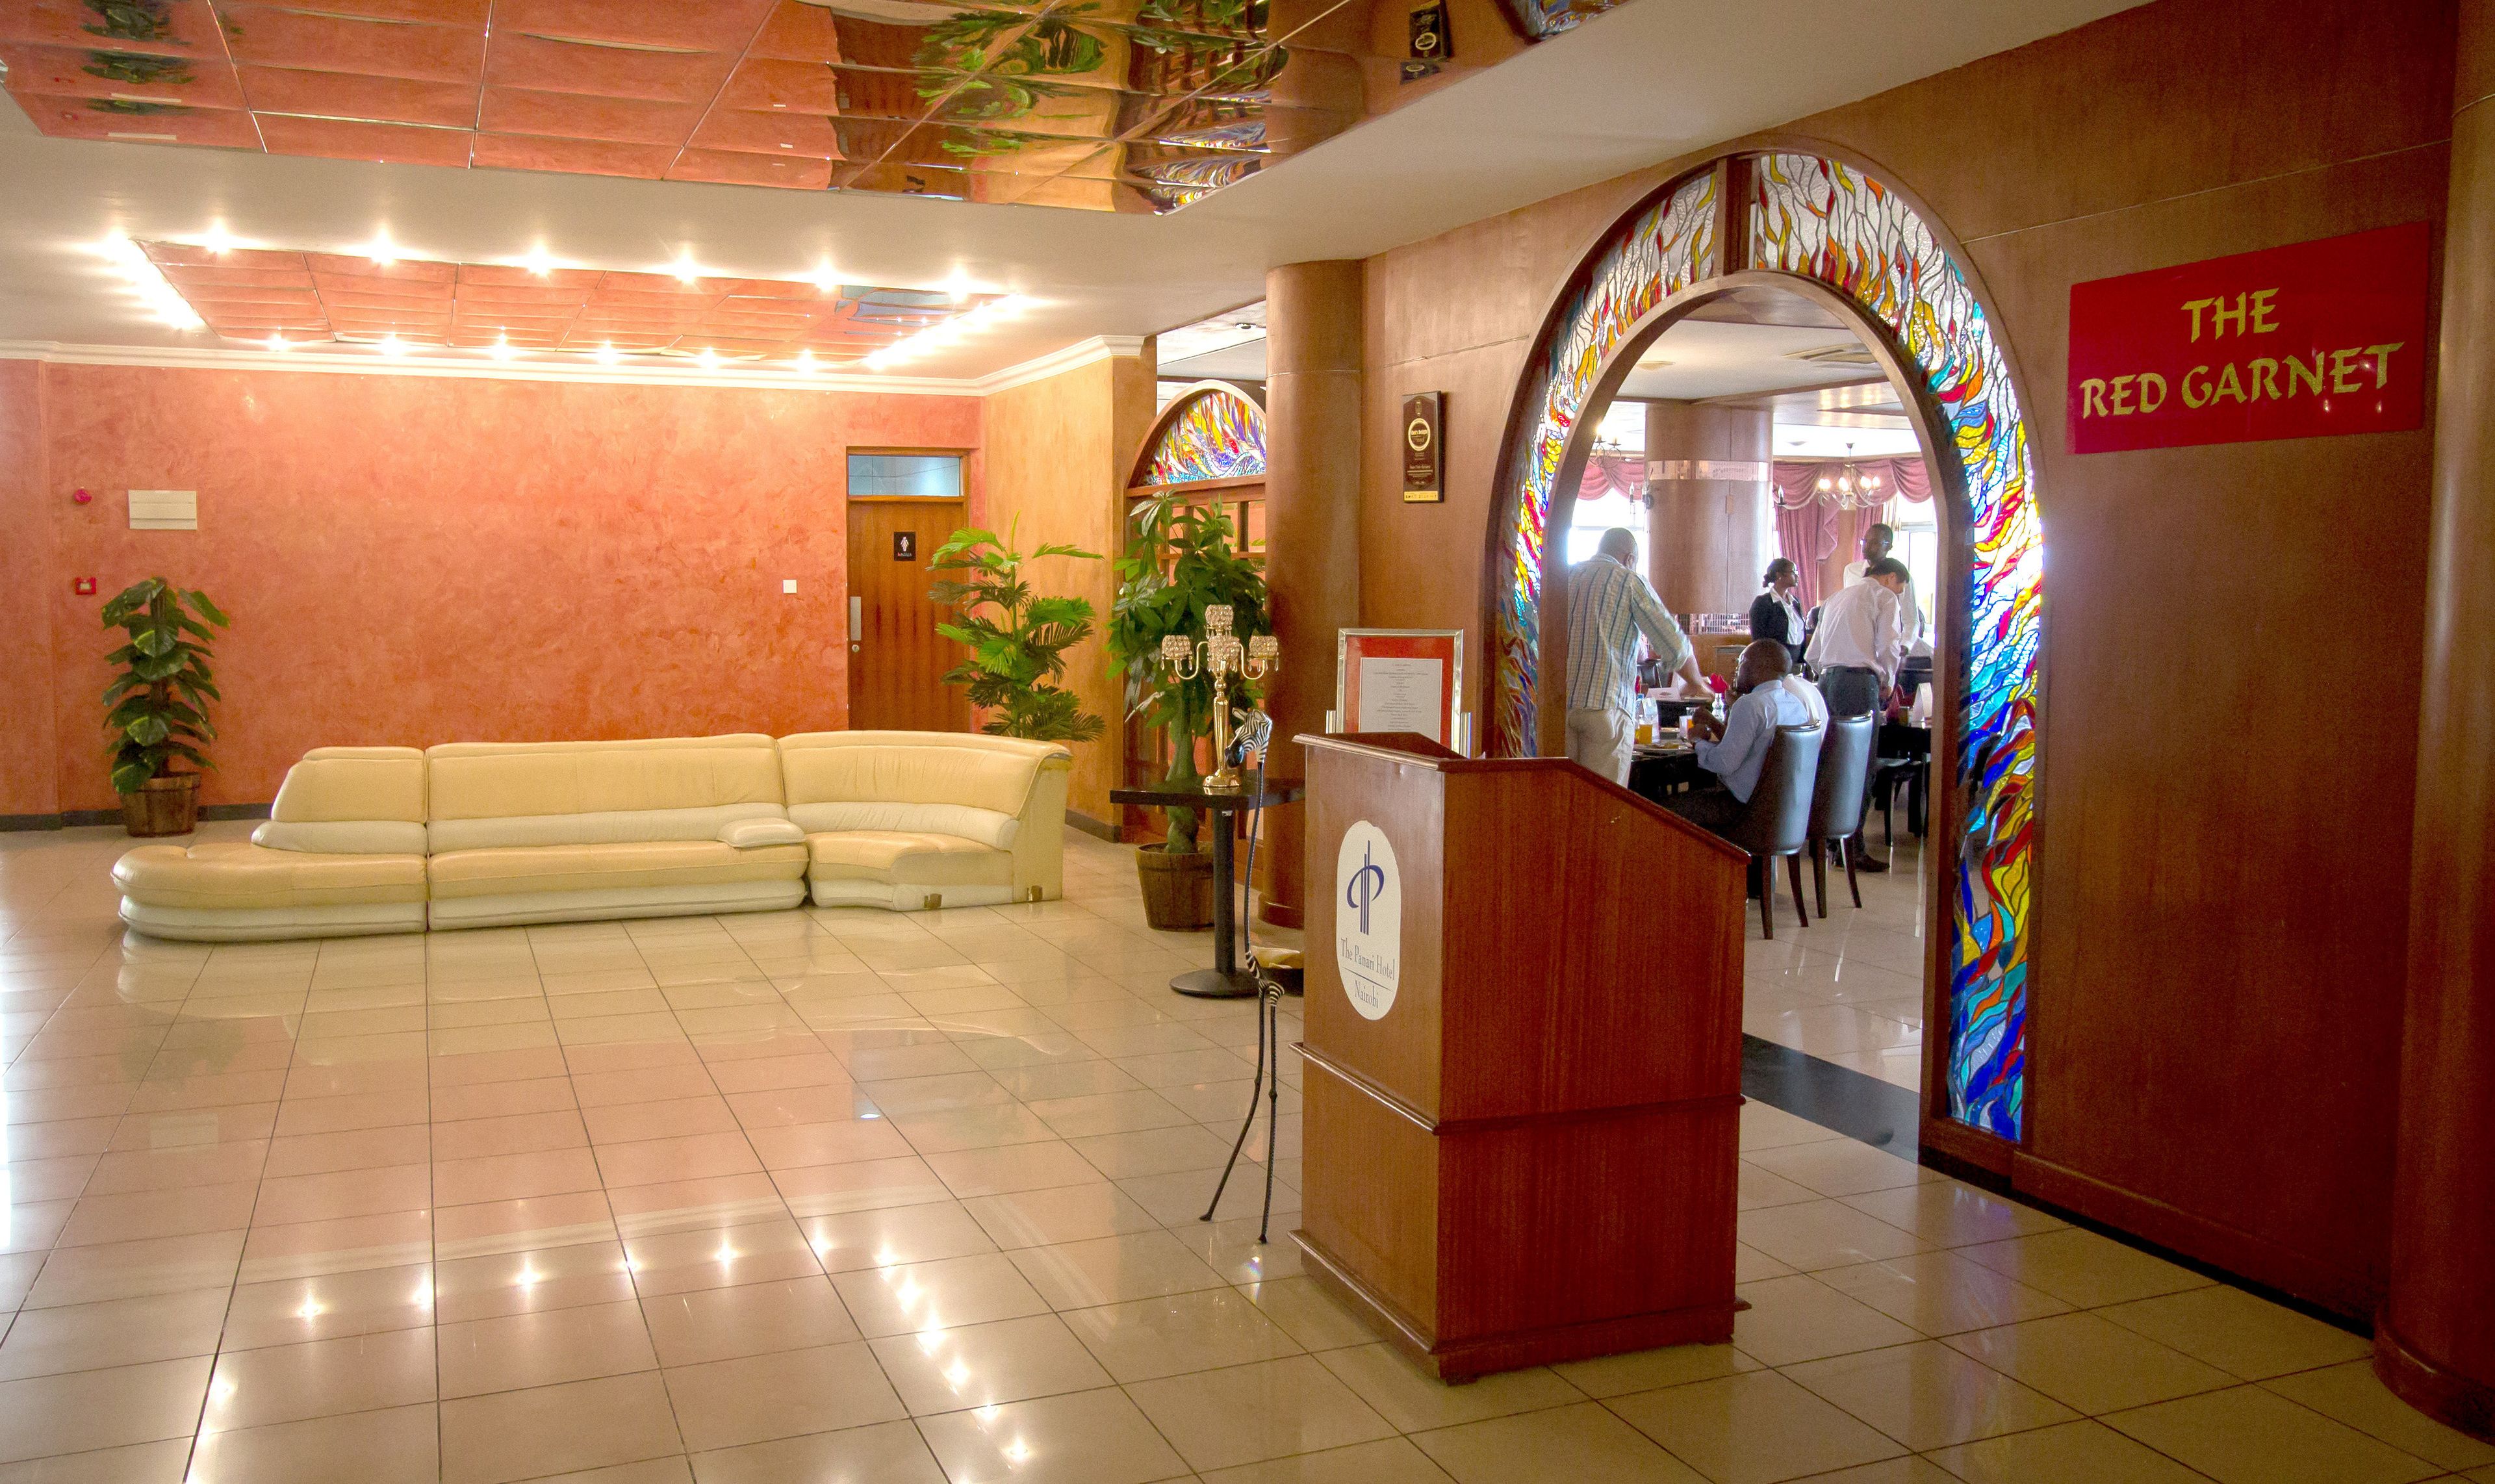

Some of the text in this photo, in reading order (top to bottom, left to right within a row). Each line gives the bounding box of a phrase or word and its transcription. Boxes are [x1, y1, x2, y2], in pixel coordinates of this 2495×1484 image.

[2181, 287, 2280, 343] THE
[2080, 342, 2405, 419] RED GARNET
[1341, 938, 1395, 980] The Panari Hotel
[1355, 980, 1378, 1008] Nairobi
